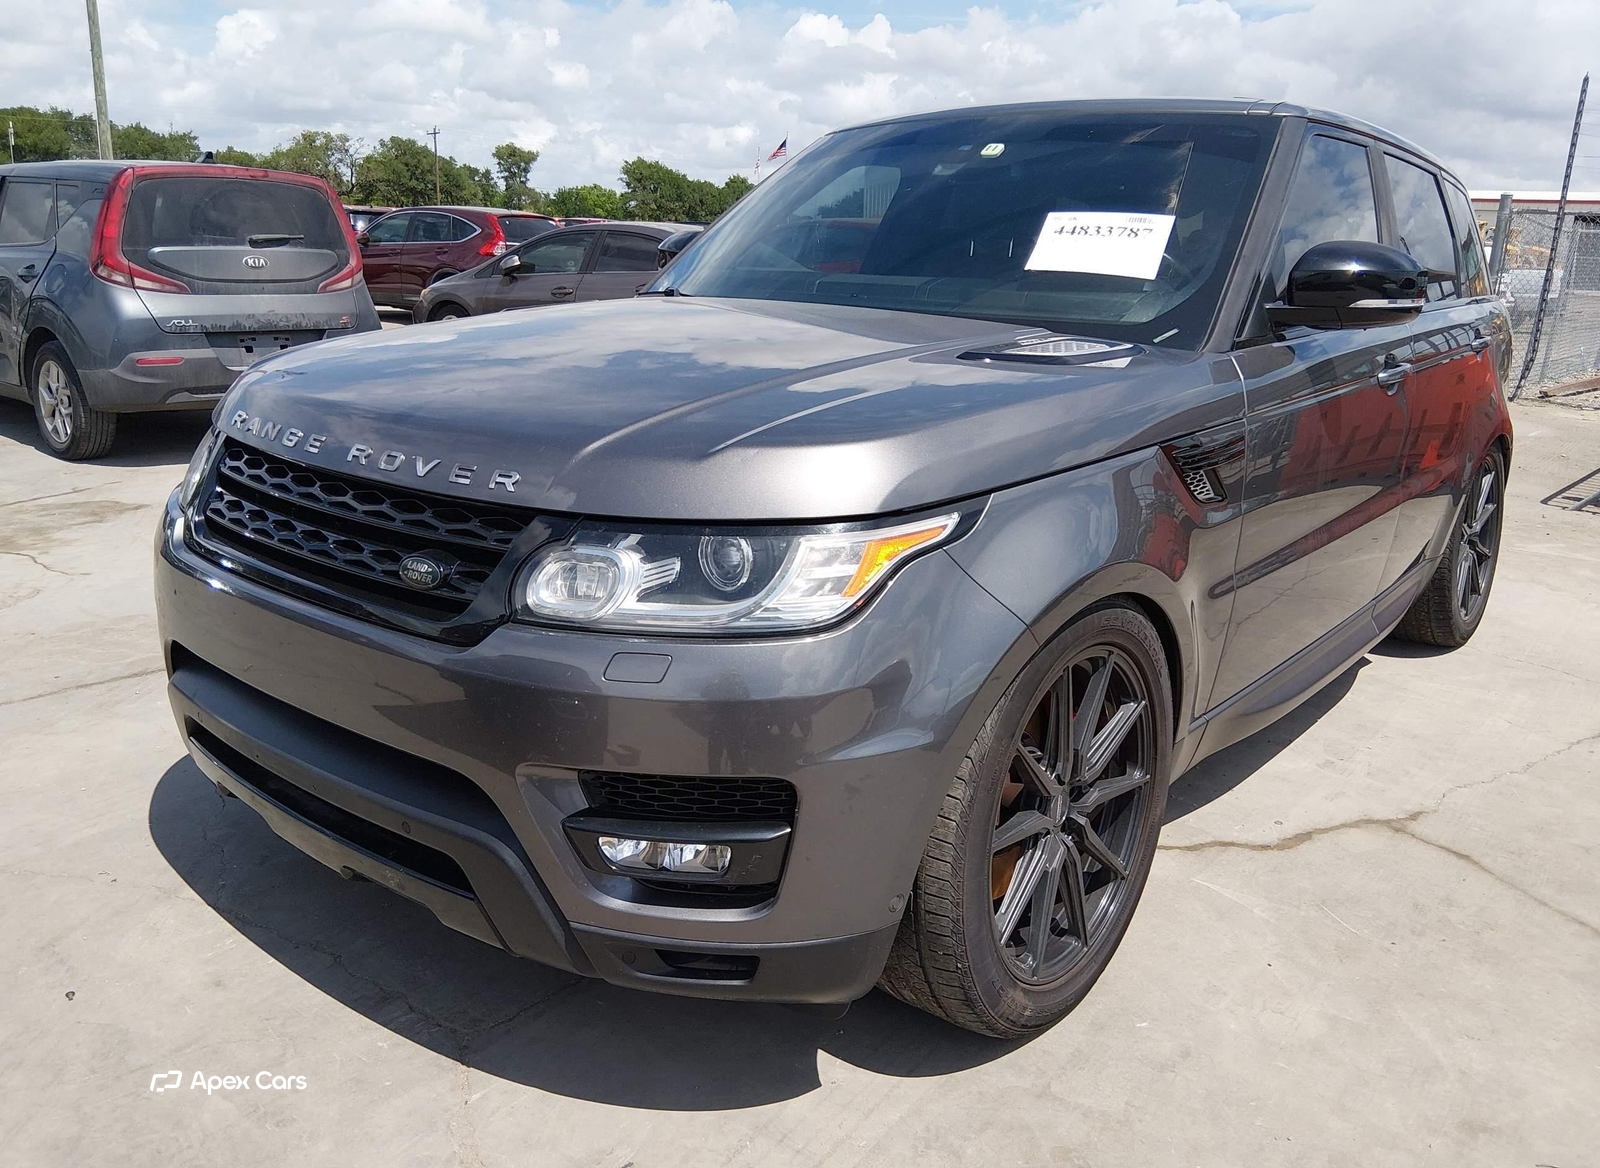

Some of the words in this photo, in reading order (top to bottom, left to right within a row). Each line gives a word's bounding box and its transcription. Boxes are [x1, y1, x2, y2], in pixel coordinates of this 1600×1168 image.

[1054, 225, 1154, 239] 44833787
[247, 258, 266, 267] KIA
[166, 319, 199, 327] SOUL
[231, 410, 328, 453] RANGE
[346, 443, 522, 493] ROVER
[407, 560, 429, 572] LAND
[407, 570, 433, 583] ROVER
